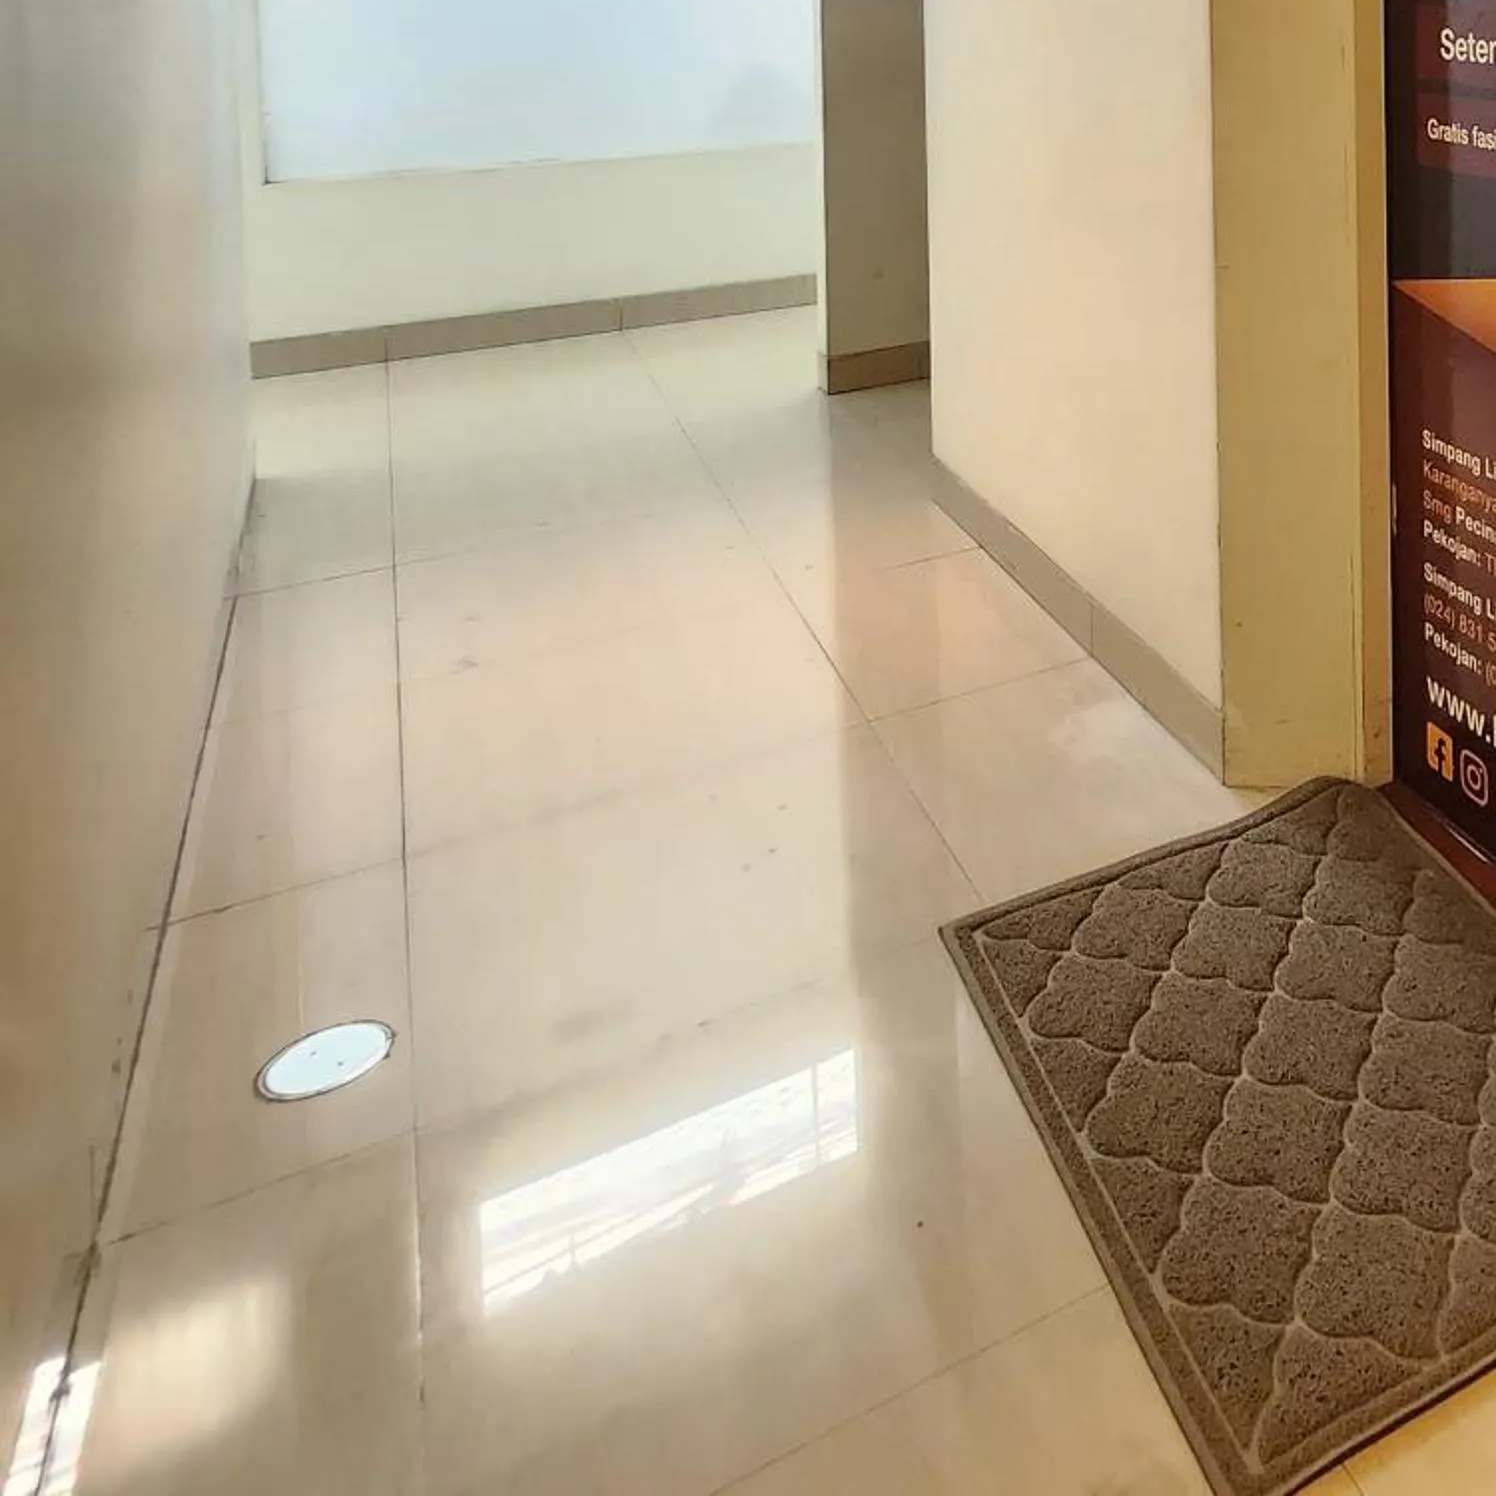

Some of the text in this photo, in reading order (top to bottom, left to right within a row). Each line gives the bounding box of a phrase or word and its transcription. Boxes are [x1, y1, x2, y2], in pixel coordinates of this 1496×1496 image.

[1427, 118, 1469, 145] Gratis
[1422, 429, 1481, 476] Simpang
[1423, 490, 1452, 524] Smg
[1423, 562, 1482, 616] Simpang
[1424, 592, 1455, 631] (024)
[1459, 613, 1483, 644] 831
[1424, 622, 1483, 675] Pekojan:
